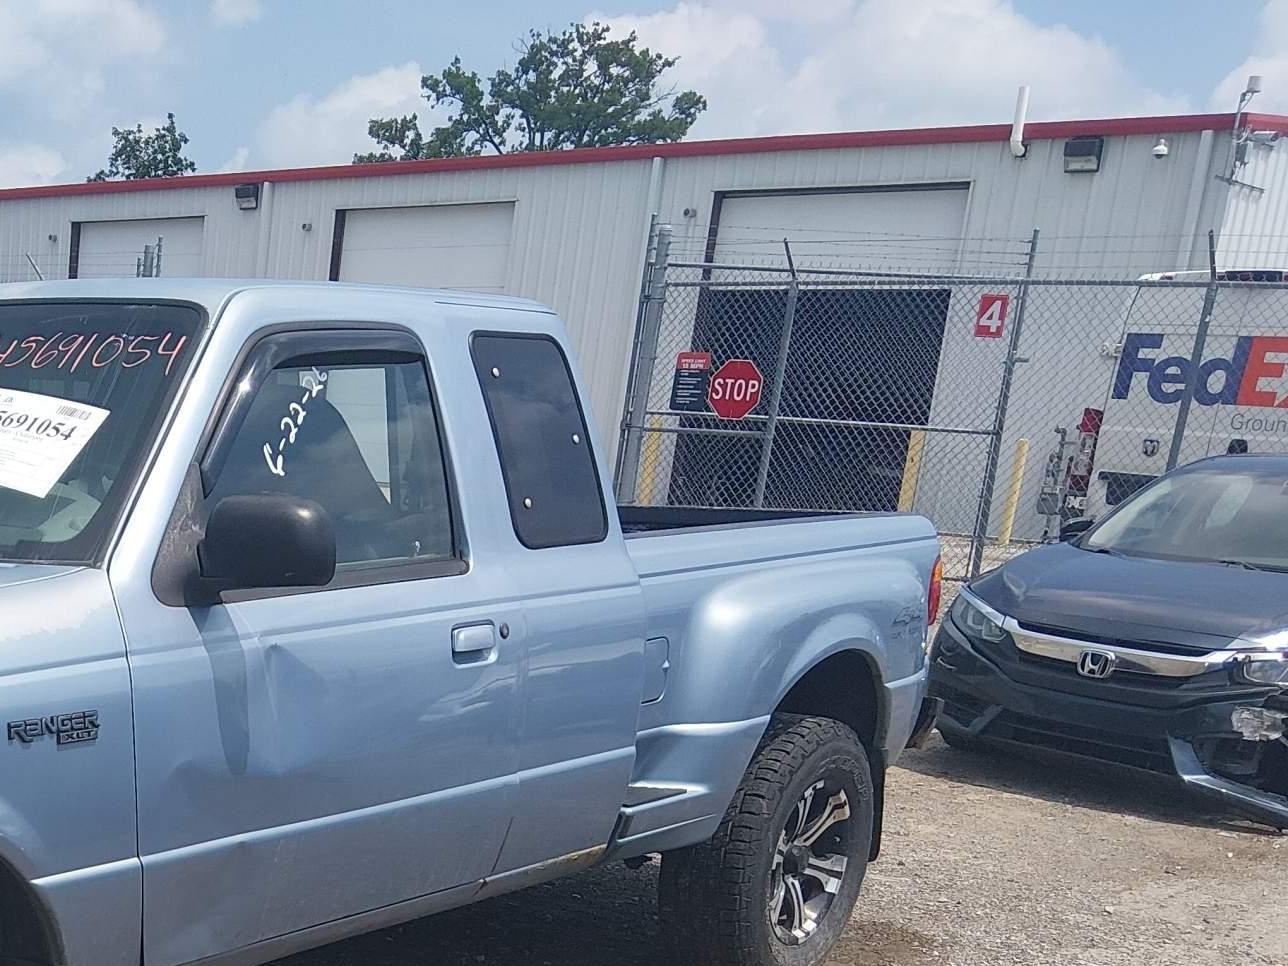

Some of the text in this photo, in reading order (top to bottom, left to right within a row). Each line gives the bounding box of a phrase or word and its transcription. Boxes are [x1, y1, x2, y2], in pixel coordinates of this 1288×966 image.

[979, 300, 1002, 333] 4
[1112, 333, 1288, 407] FedE
[712, 378, 759, 402] STOP
[60, 730, 96, 743] XLT
